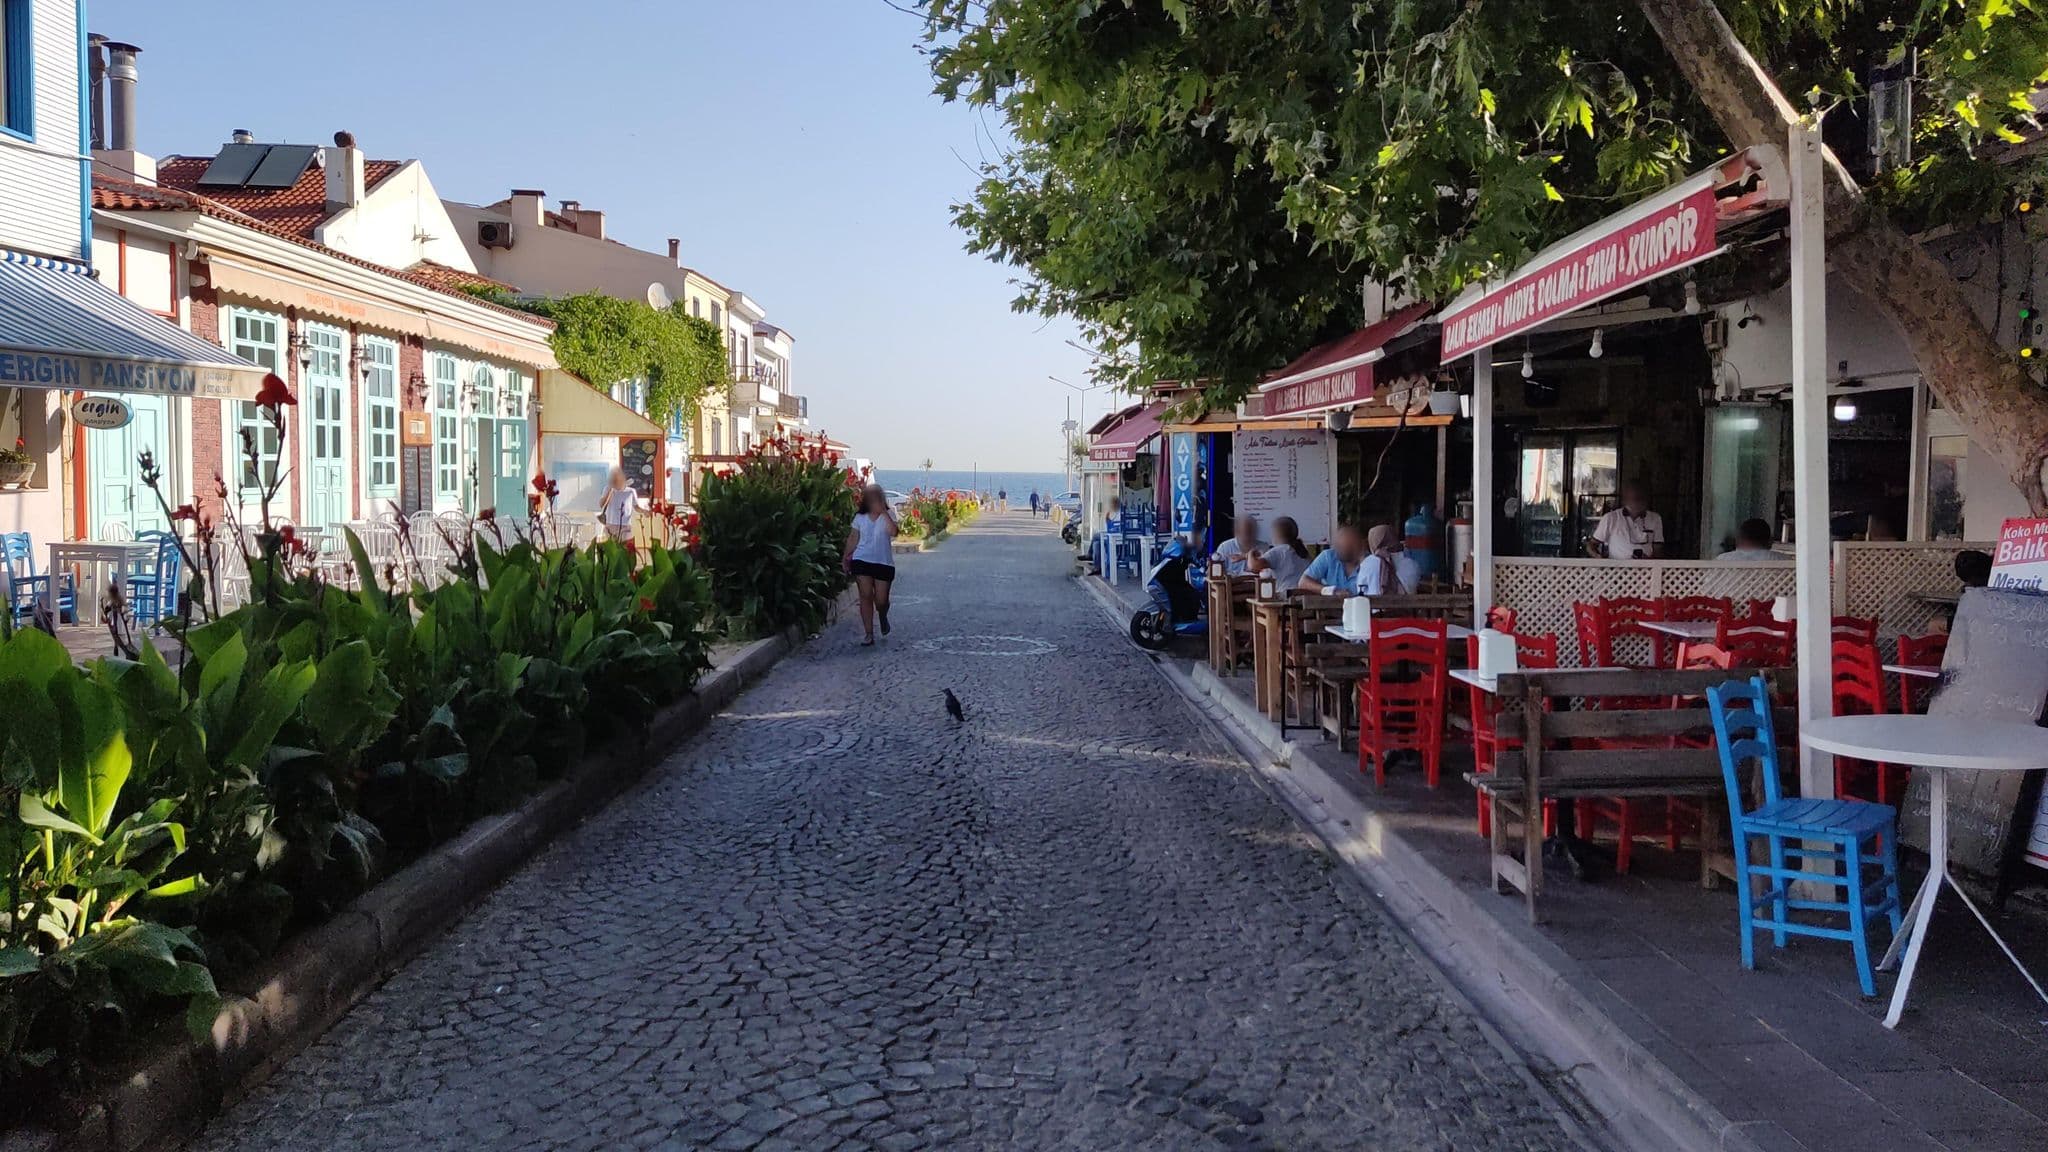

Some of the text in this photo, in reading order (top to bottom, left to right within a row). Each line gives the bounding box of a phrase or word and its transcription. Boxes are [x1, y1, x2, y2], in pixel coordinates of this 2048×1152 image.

[1537, 261, 1579, 312] DOLMA
[1586, 243, 1617, 292] TAVA
[1625, 201, 1698, 276] KUMPİR
[1331, 371, 1356, 400] SALONU
[82, 400, 120, 417] ergin
[1176, 437, 1190, 527] AYGAZ
[2003, 525, 2031, 539] Koko
